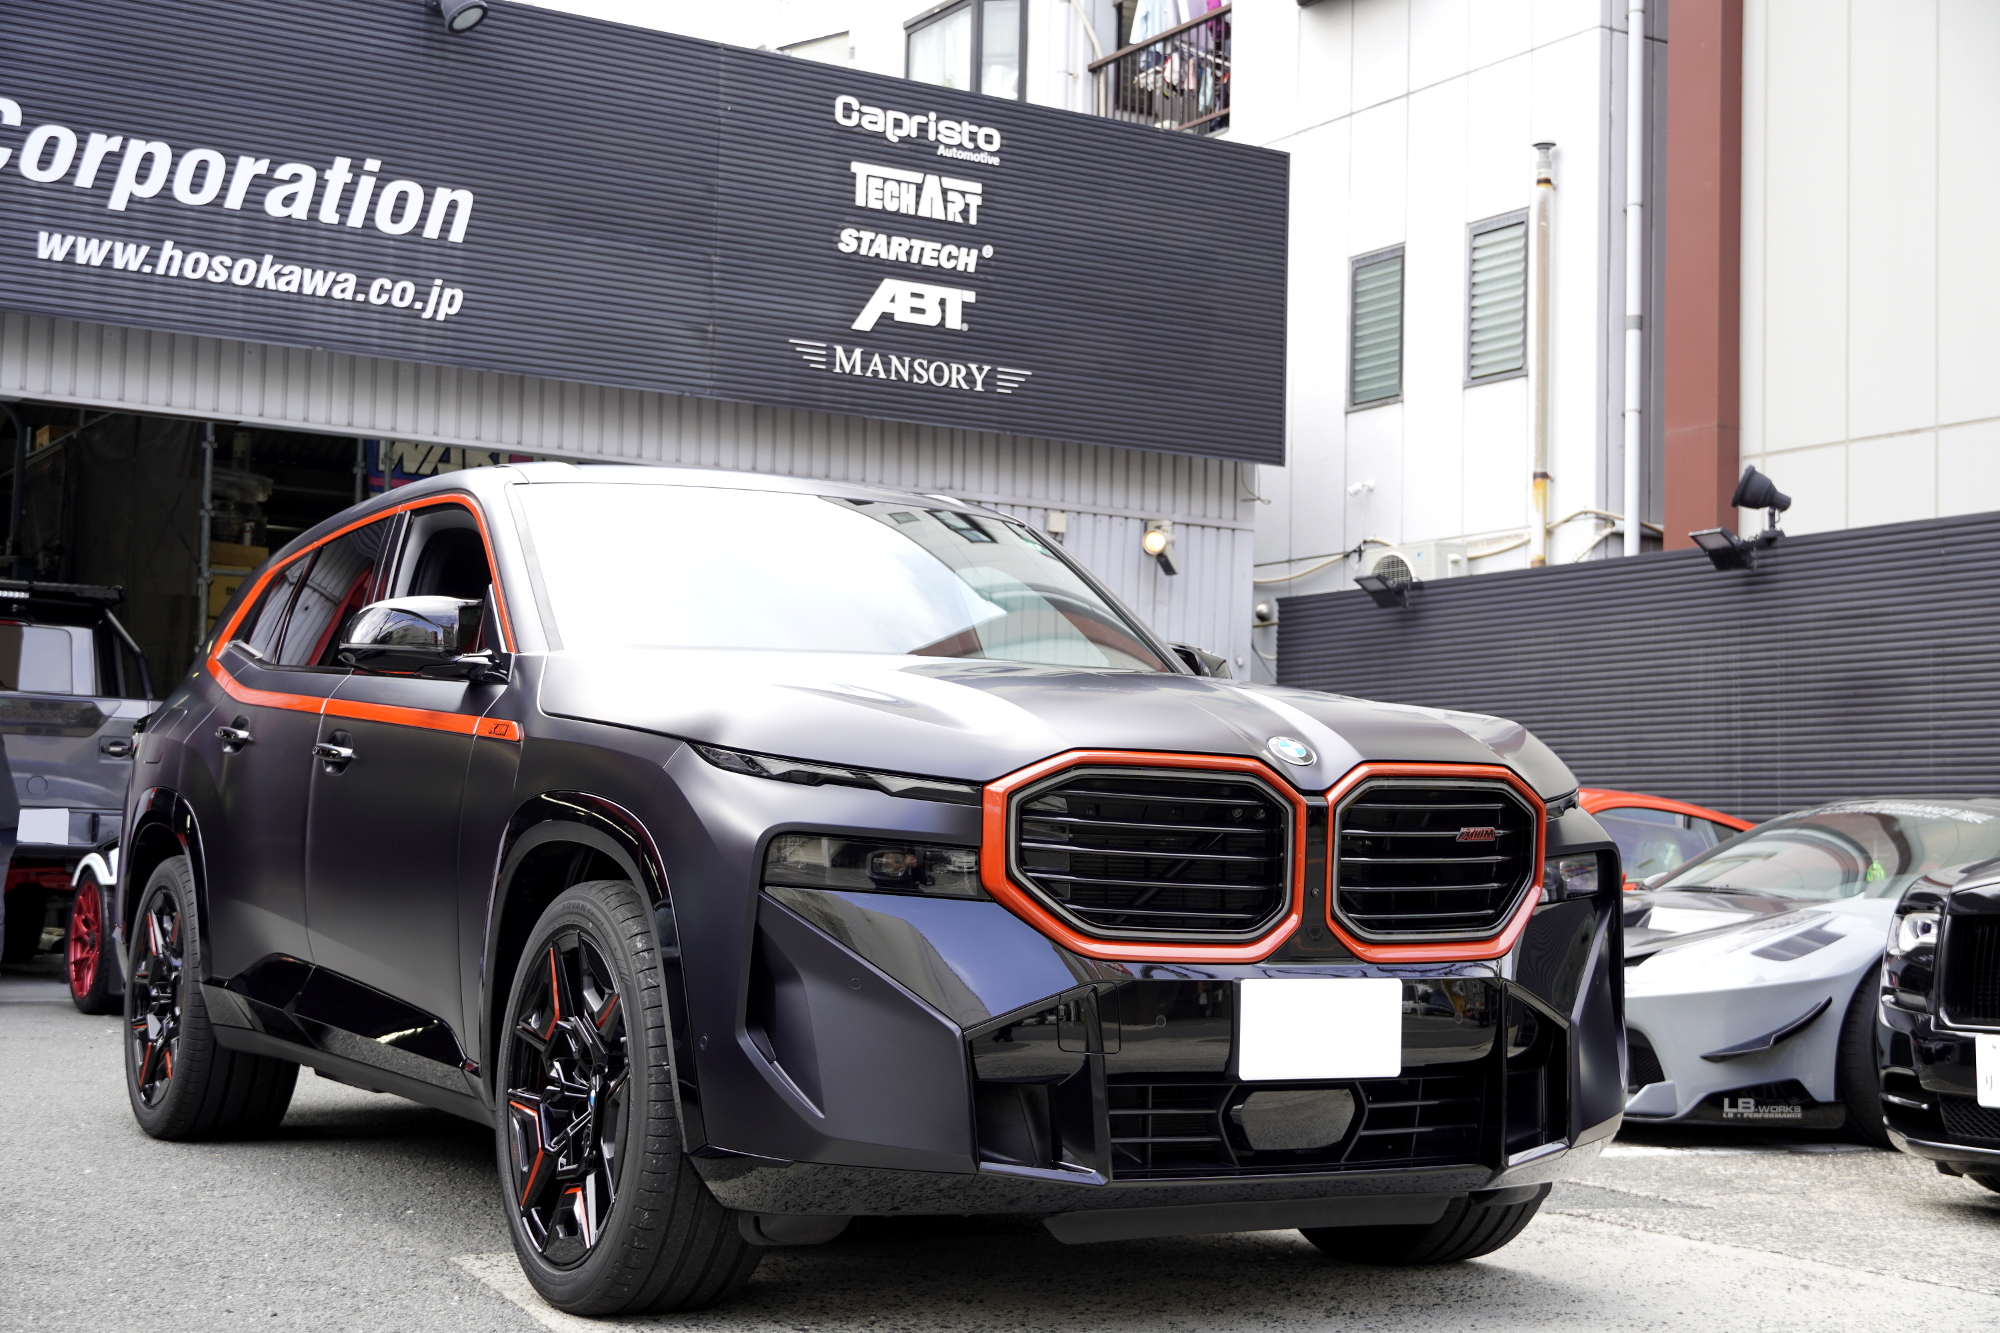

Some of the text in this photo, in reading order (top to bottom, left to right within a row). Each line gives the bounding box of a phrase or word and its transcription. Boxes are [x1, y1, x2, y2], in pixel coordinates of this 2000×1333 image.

[834, 95, 1001, 152] Capristo
[937, 144, 1001, 166] Automotive
[850, 161, 983, 225] TECHART
[37, 231, 465, 321] www.hosokawa.co.jp
[851, 278, 976, 332] ABT
[833, 345, 992, 392] MANSORY
